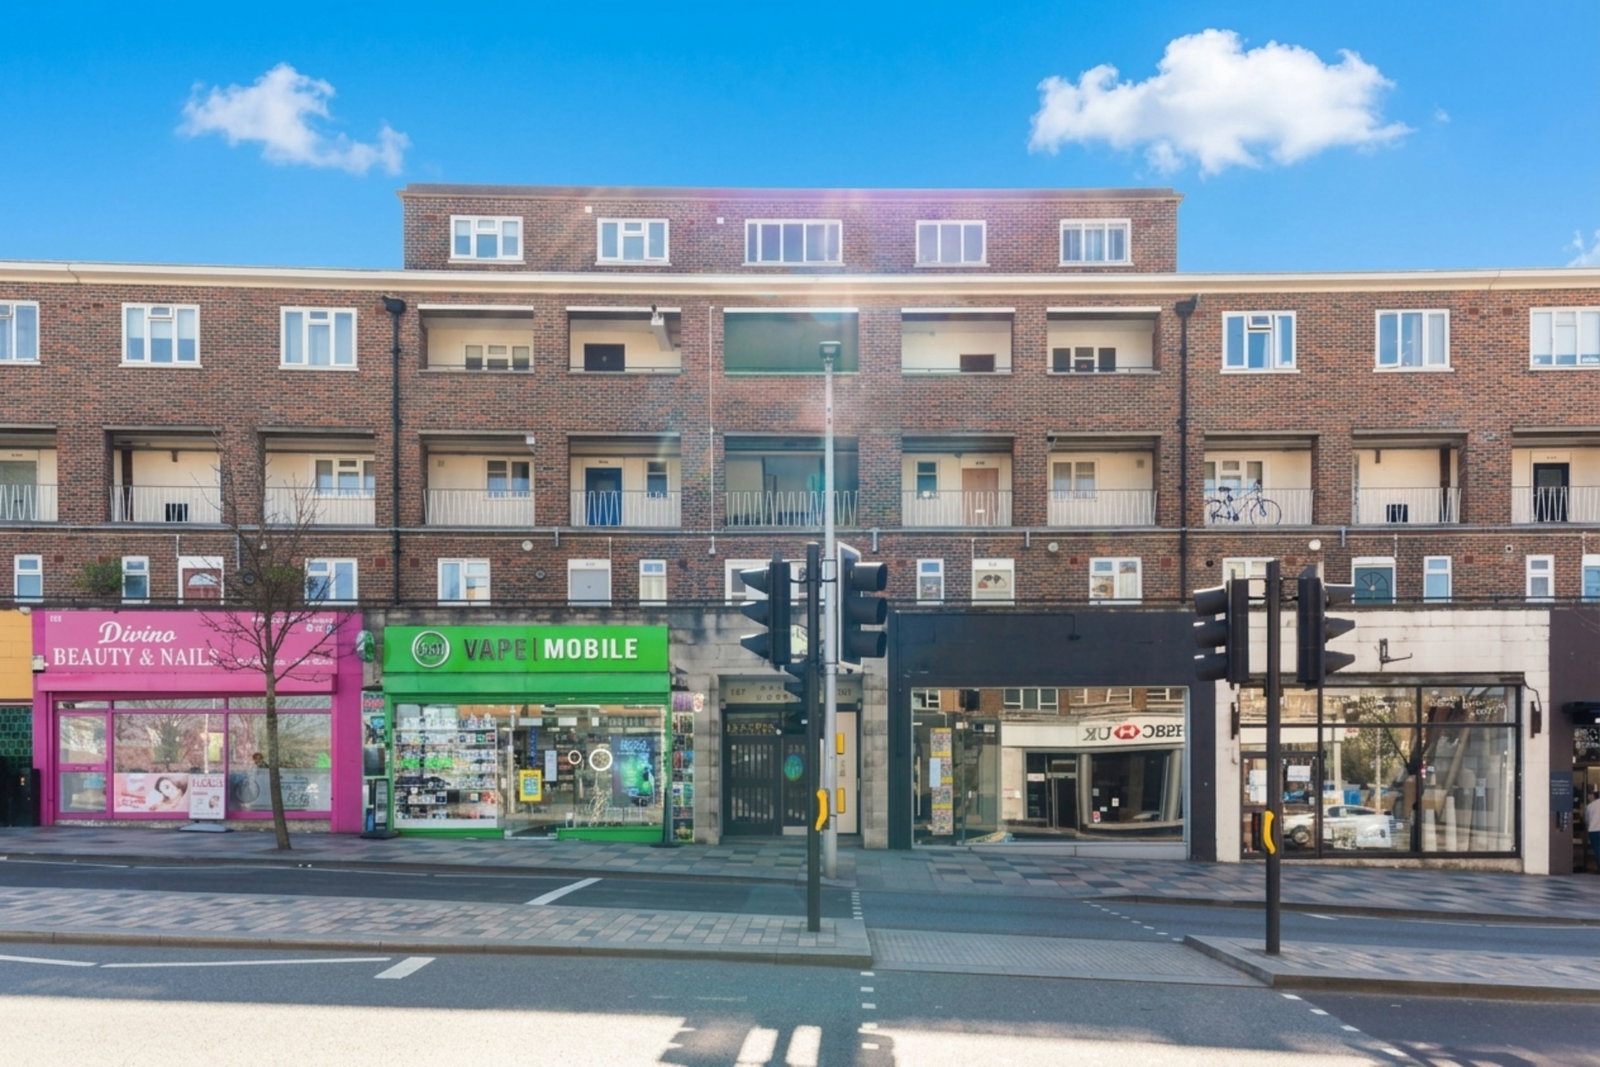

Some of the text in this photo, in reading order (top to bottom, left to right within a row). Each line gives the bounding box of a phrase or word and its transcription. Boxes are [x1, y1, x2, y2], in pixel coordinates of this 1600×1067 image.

[98, 621, 177, 644] Divino
[53, 648, 135, 666] BEAUTY
[139, 648, 155, 666] &
[161, 648, 220, 667] NAILS
[463, 638, 527, 660] VAPE
[544, 638, 638, 659] MOBILE
